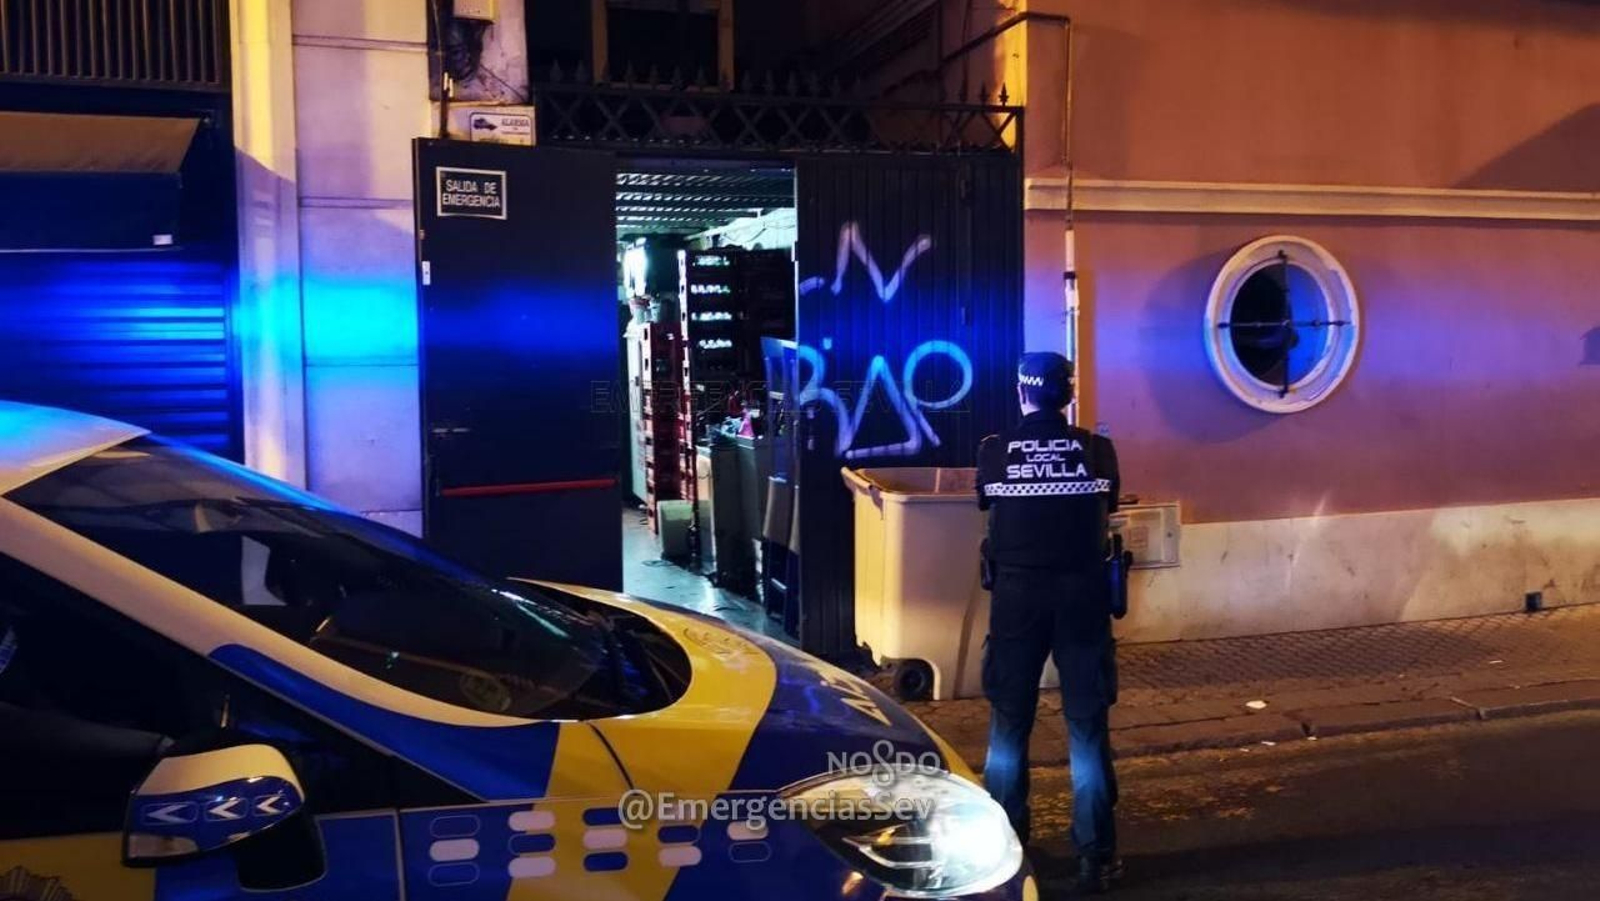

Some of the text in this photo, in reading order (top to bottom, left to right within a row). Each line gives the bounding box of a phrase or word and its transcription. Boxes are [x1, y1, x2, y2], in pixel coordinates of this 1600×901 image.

[446, 180, 497, 194] SALIDA DE
[442, 193, 500, 207] EMERGENCIA
[1007, 439, 1082, 453] POLICIA
[1026, 453, 1066, 462] LOCAL
[1006, 463, 1087, 479] SEVILLA
